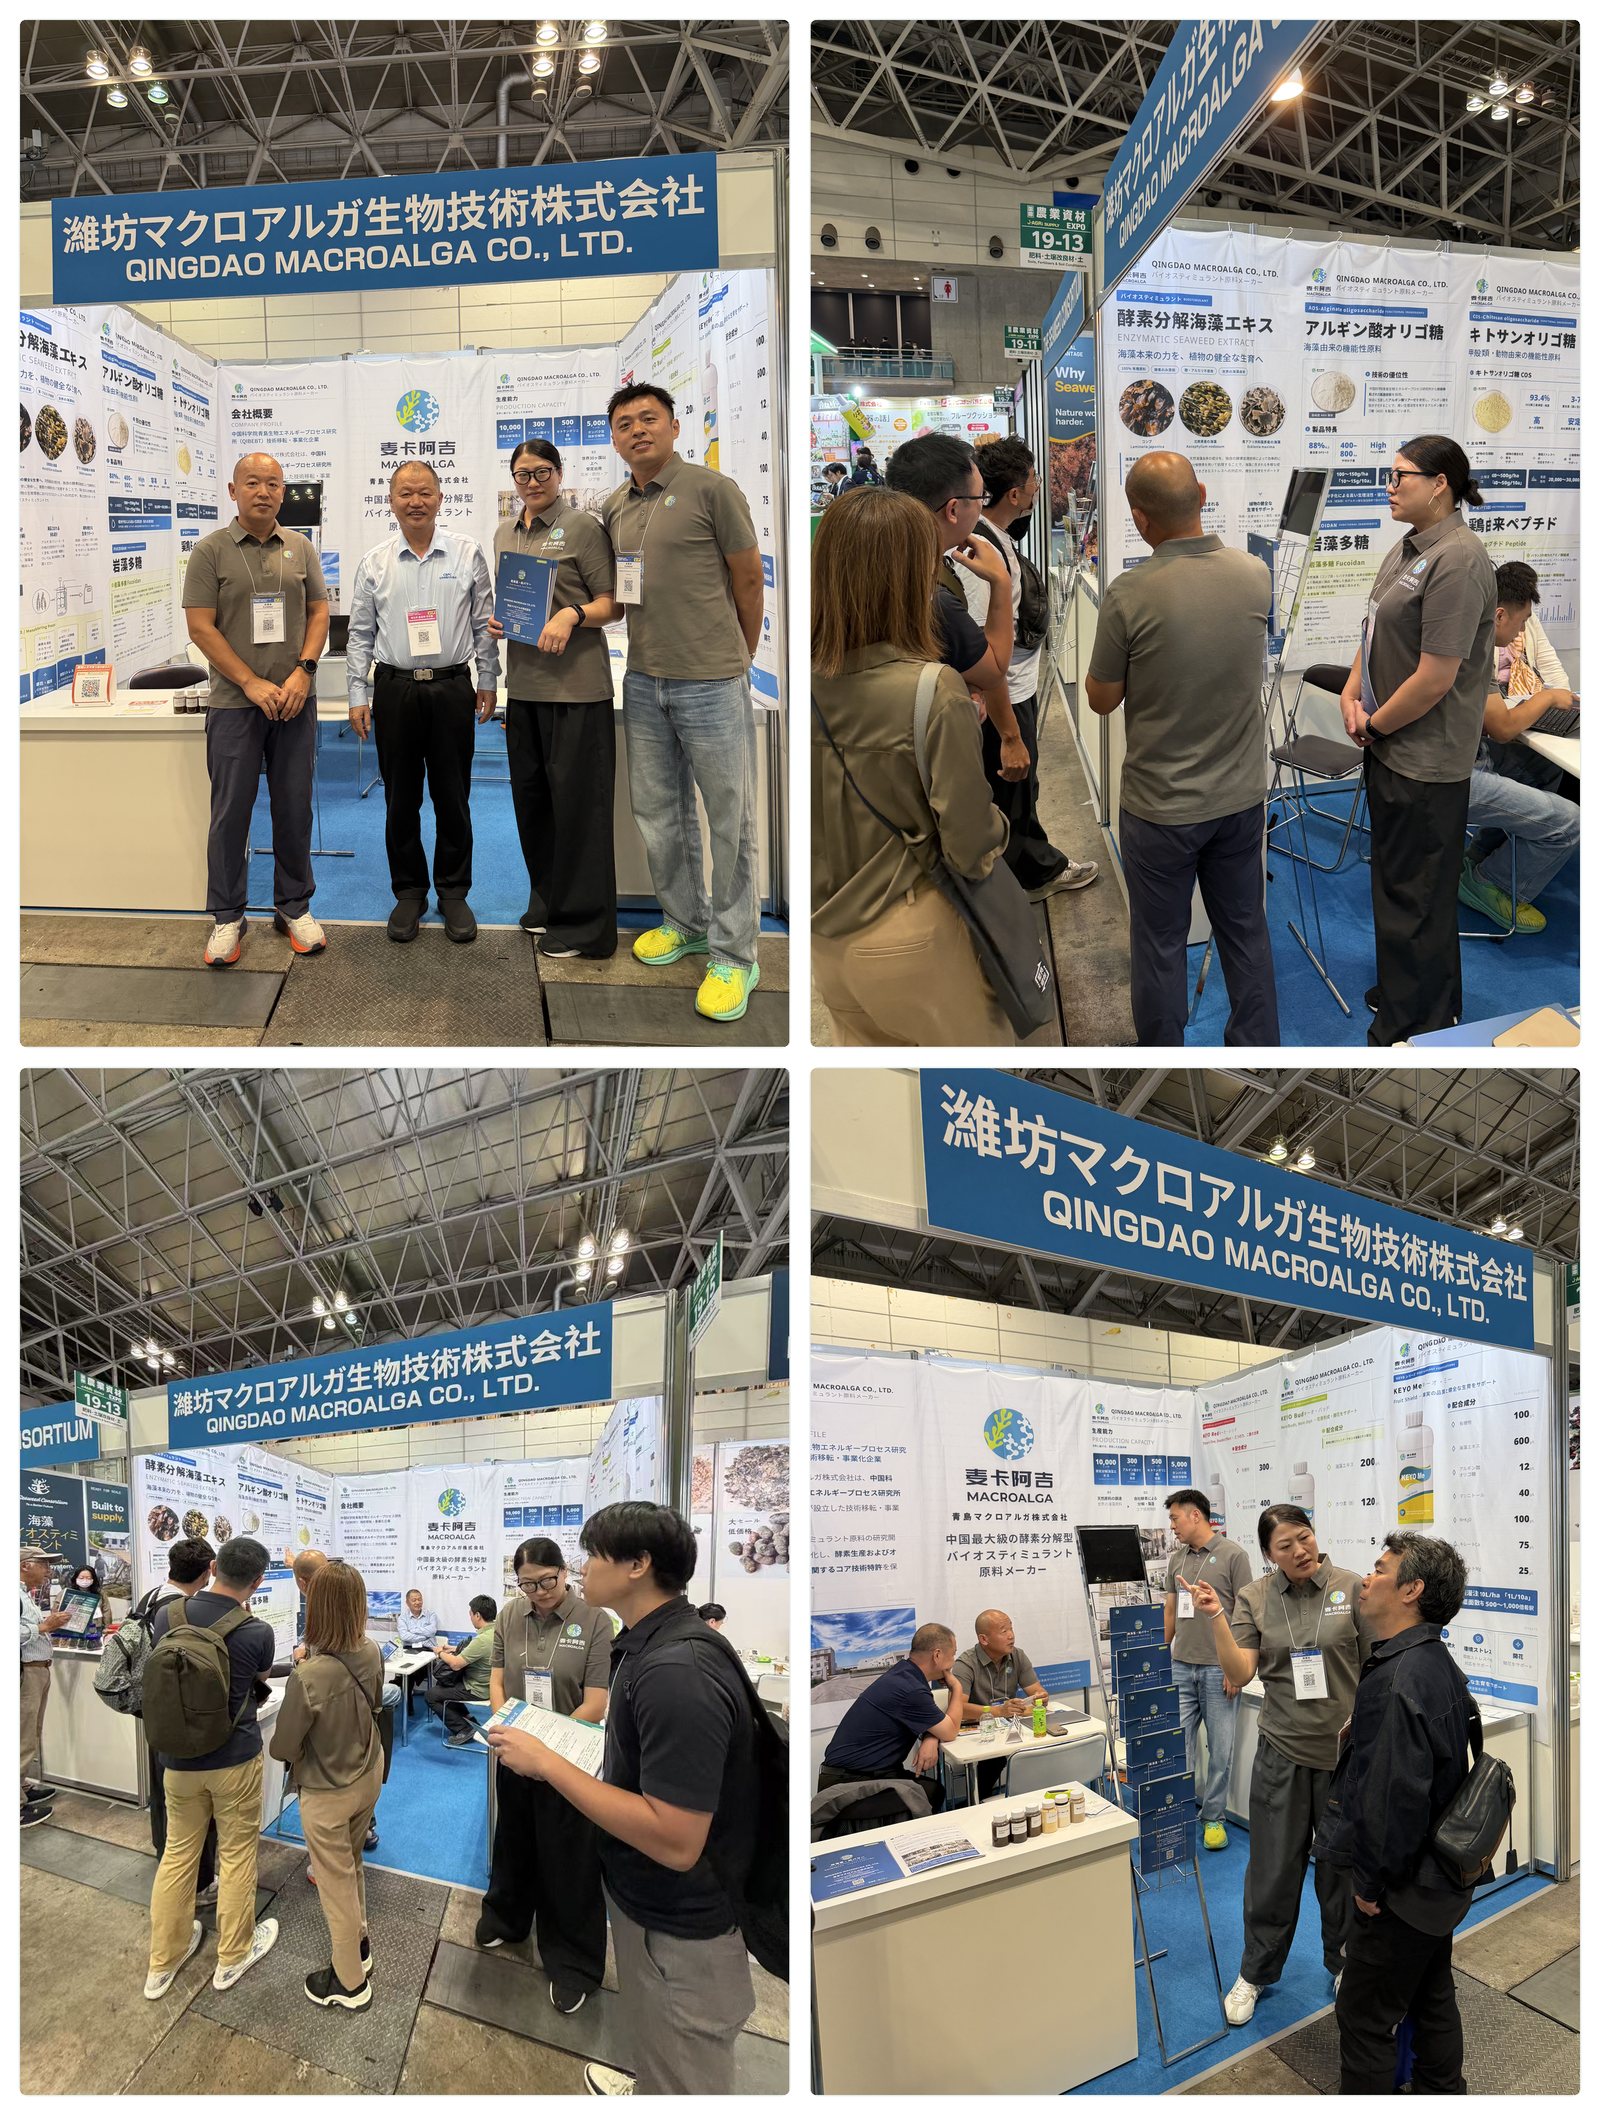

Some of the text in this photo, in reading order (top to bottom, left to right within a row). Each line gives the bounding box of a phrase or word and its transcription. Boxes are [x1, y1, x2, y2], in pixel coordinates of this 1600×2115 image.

[1036, 206, 1086, 222] 農業資材
[1066, 222, 1086, 230] EXPO
[1032, 230, 1084, 252] 19-13
[125, 230, 633, 282] QINGDAO MACROALGA CO., LTD.
[1152, 260, 1279, 278] QINGDAO MACROALGA CO., LTD.
[1336, 274, 1370, 284] QINGDAO
[1372, 277, 1416, 286] MACROALGA
[1120, 293, 1182, 302] バイオスティミュラント
[1496, 286, 1527, 294] QINGDAO
[1528, 288, 1566, 298] MACROALGA
[1117, 308, 1274, 334] 酵素分解海藻エキス
[1306, 320, 1444, 341] アルギン酸オリゴ糖
[1012, 338, 1038, 350] 19-11
[1118, 334, 1255, 348] ENZYMATIC SEAWEED EXTRACT
[1470, 328, 1576, 349] キトサンオリゴ糖
[1304, 342, 1382, 354] 海藻由来の機能性原料
[1055, 366, 1085, 382] Why
[1372, 371, 1408, 379] 技術の優位性
[1476, 370, 1520, 378] キトサンオリゴ糖
[1530, 394, 1550, 402] 93.4%
[232, 408, 273, 420] 会社概要
[1056, 408, 1084, 417] Nature
[1056, 417, 1084, 426] harder.
[1534, 416, 1541, 424] 高
[1312, 426, 1338, 434] 製品特長
[380, 441, 456, 456] 麦卡阿吉
[1370, 442, 1386, 450] High
[762, 496, 768, 504] 75
[764, 528, 769, 537] 25
[940, 1084, 1528, 1302] 濰坊マクロアルガ生物技術株式会社
[1043, 1190, 1490, 1324] QINGDAO MACROALGA CO., LTD.
[1418, 1337, 1446, 1351] QINGDAO
[1294, 1374, 1318, 1386] QINGDAO
[1319, 1366, 1351, 1380] MACROALGA
[1362, 1358, 1374, 1366] LTD.
[813, 1384, 860, 1392] MACROALGA
[1393, 1382, 1422, 1395] KEYO Me
[84, 1393, 122, 1416] 19-13
[206, 1374, 540, 1434] QINGDAO MACROALGA CO., LTD.
[1451, 1398, 1476, 1410] 配合成分
[1294, 1410, 1304, 1419] Bud
[1514, 1410, 1530, 1420] 100
[1514, 1436, 1530, 1446] 600
[1258, 1463, 1270, 1472] 300
[1360, 1458, 1376, 1468] 200
[1519, 1462, 1530, 1471] 12
[145, 1458, 226, 1487] 酵素分解海藻エキス
[966, 1468, 1053, 1488] 麦卡阿吉
[967, 1492, 1054, 1504] MACROALGA
[1518, 1488, 1530, 1497] 40
[92, 1500, 124, 1512] Built to
[340, 1502, 364, 1510] 会社概要
[1360, 1498, 1376, 1507] 120
[28, 1514, 54, 1528] 海藻
[92, 1512, 124, 1523] supply.
[952, 1512, 1068, 1522] 青島マクロアルガ株式会社
[1514, 1515, 1530, 1523] 100
[428, 1522, 476, 1532] 麦卡阿吉
[946, 1532, 1073, 1545] 中国最大級の酵素分解型
[1370, 1537, 1376, 1546] 5
[1518, 1541, 1530, 1550] 75
[946, 1548, 1072, 1562] バイオスティミュラント
[417, 1565, 486, 1573] バイオスティミュラント
[980, 1566, 1046, 1578] 原料メーカー
[1518, 1566, 1529, 1575] 25
